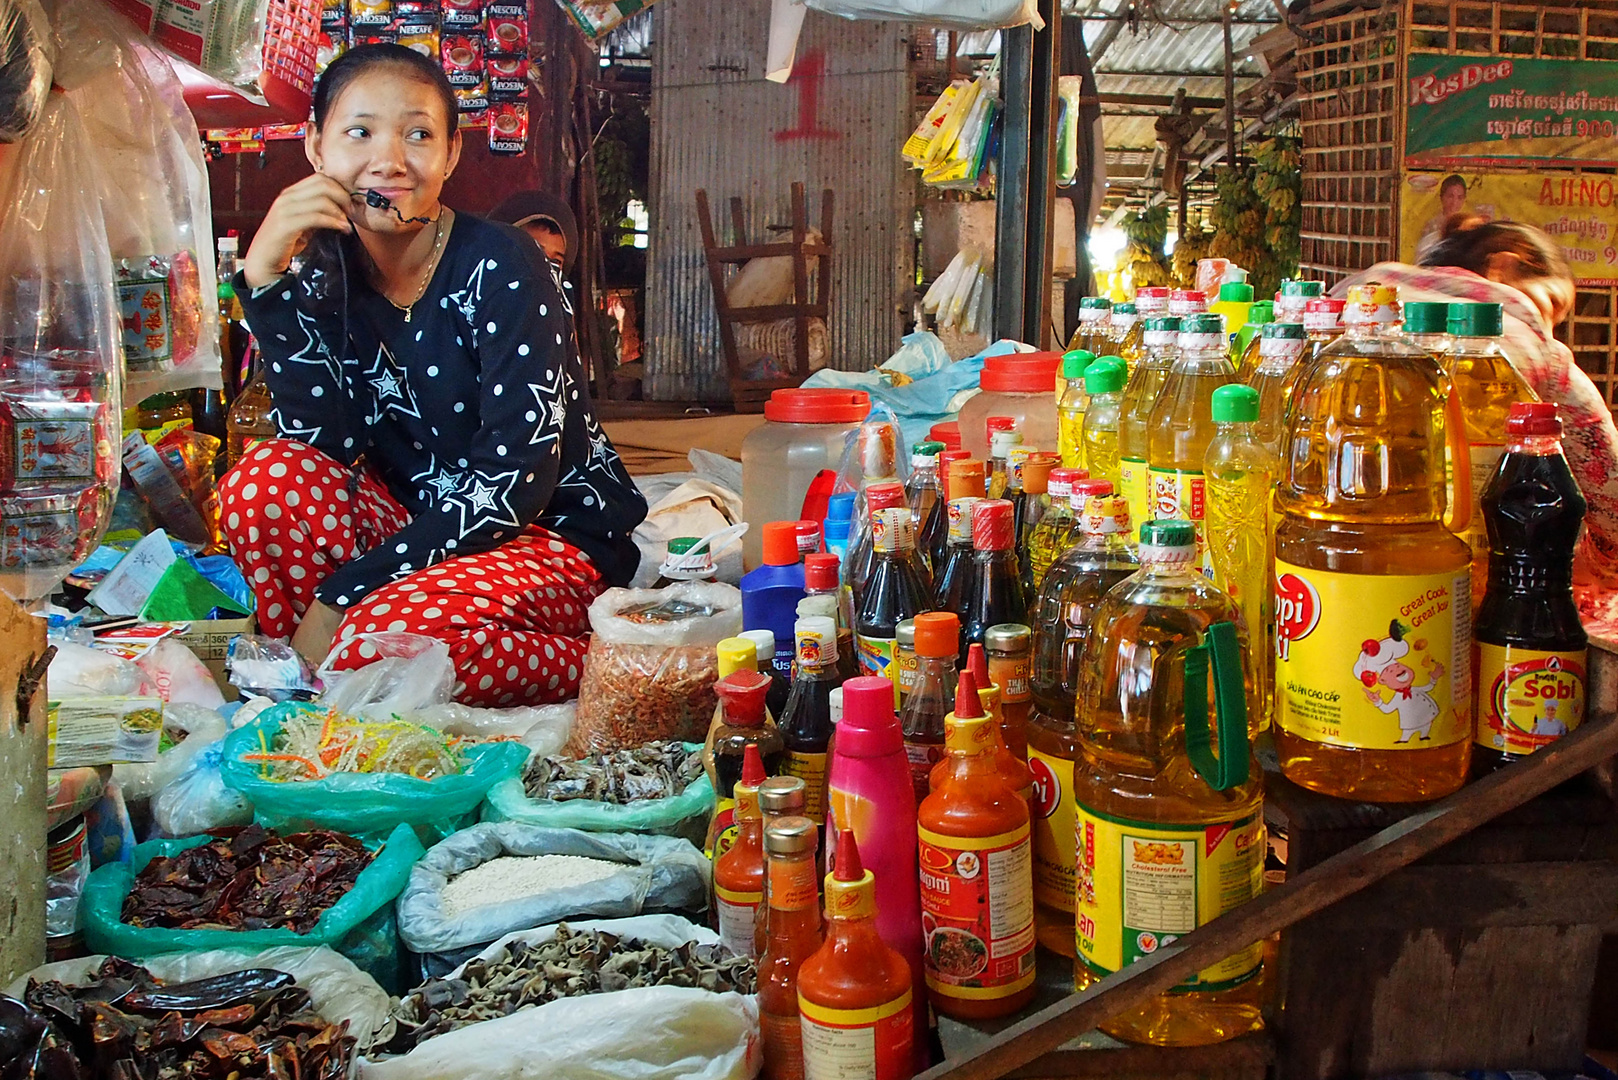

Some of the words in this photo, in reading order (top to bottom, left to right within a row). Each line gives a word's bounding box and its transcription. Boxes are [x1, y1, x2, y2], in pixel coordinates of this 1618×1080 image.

[1576, 119, 1613, 138] 900
[1400, 594, 1425, 617] Great
[1427, 585, 1449, 601] Cook
[1411, 606, 1436, 628] Great
[1524, 679, 1576, 700] Sobi
[1131, 863, 1171, 874] Cholesterol
